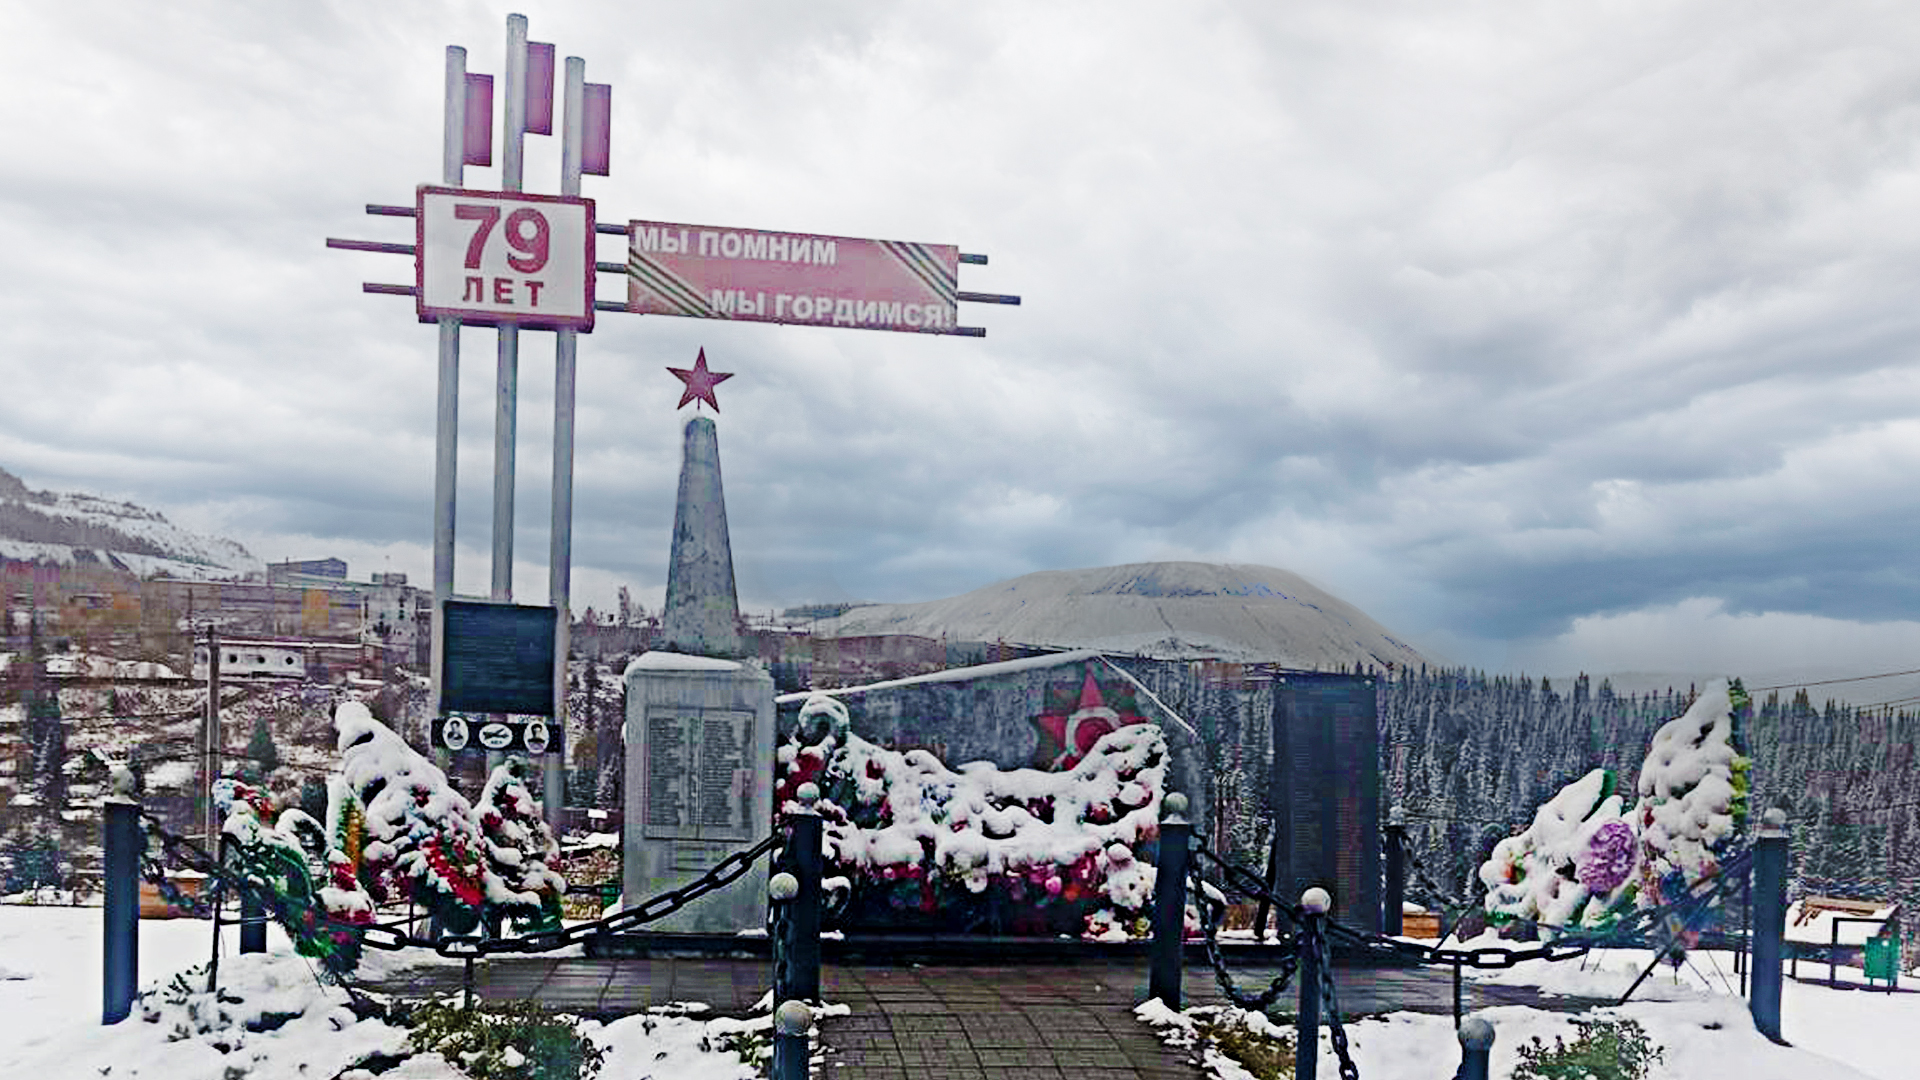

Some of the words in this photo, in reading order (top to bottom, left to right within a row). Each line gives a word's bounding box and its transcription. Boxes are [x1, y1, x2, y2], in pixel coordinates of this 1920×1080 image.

[454, 204, 550, 274] 79
[634, 226, 689, 254] МЫ
[700, 231, 838, 266] ПОМНИМ
[462, 276, 545, 307] ЛЕТ
[711, 288, 766, 316] МЫ
[775, 294, 952, 328] ГОРДИМСЯ!
